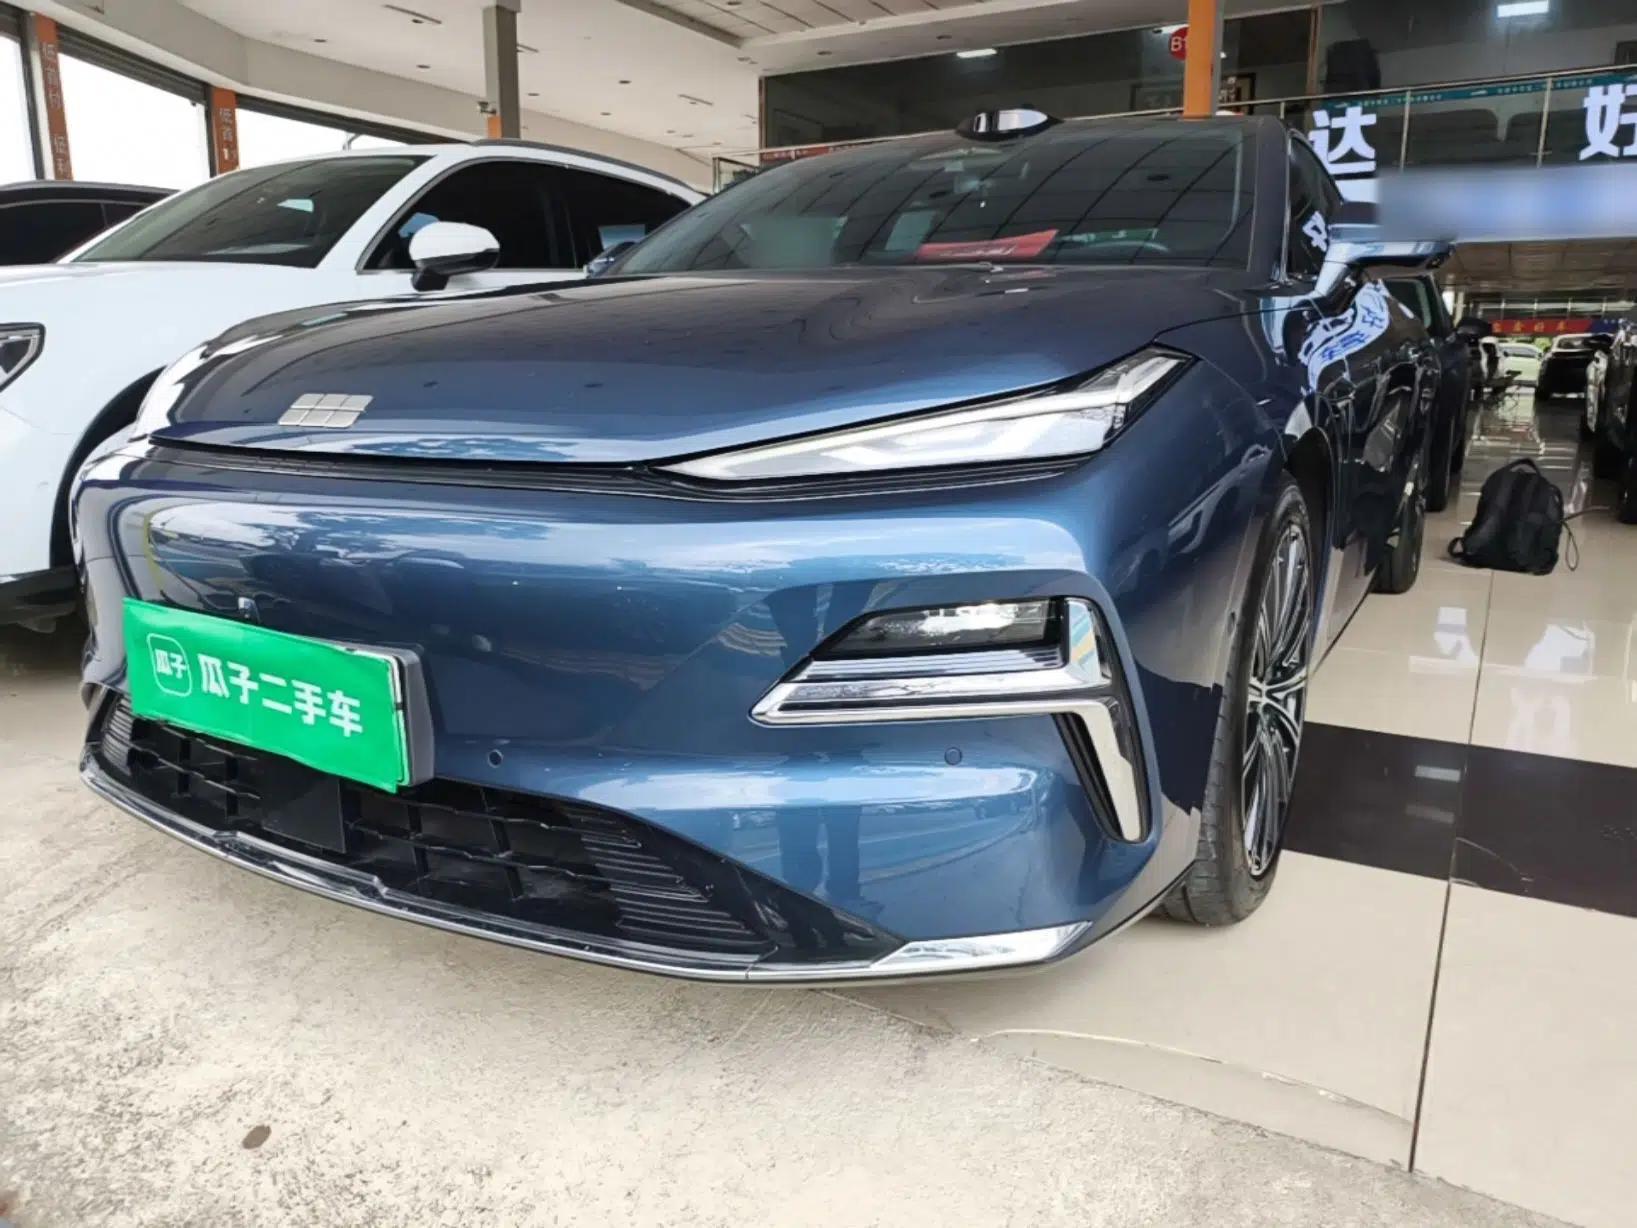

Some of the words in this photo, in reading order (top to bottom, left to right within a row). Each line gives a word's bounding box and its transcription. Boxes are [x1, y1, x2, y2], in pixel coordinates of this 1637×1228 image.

[1308, 105, 1377, 175] 达
[154, 648, 188, 680] 瓜子
[197, 652, 364, 738] 瓜子二手车
